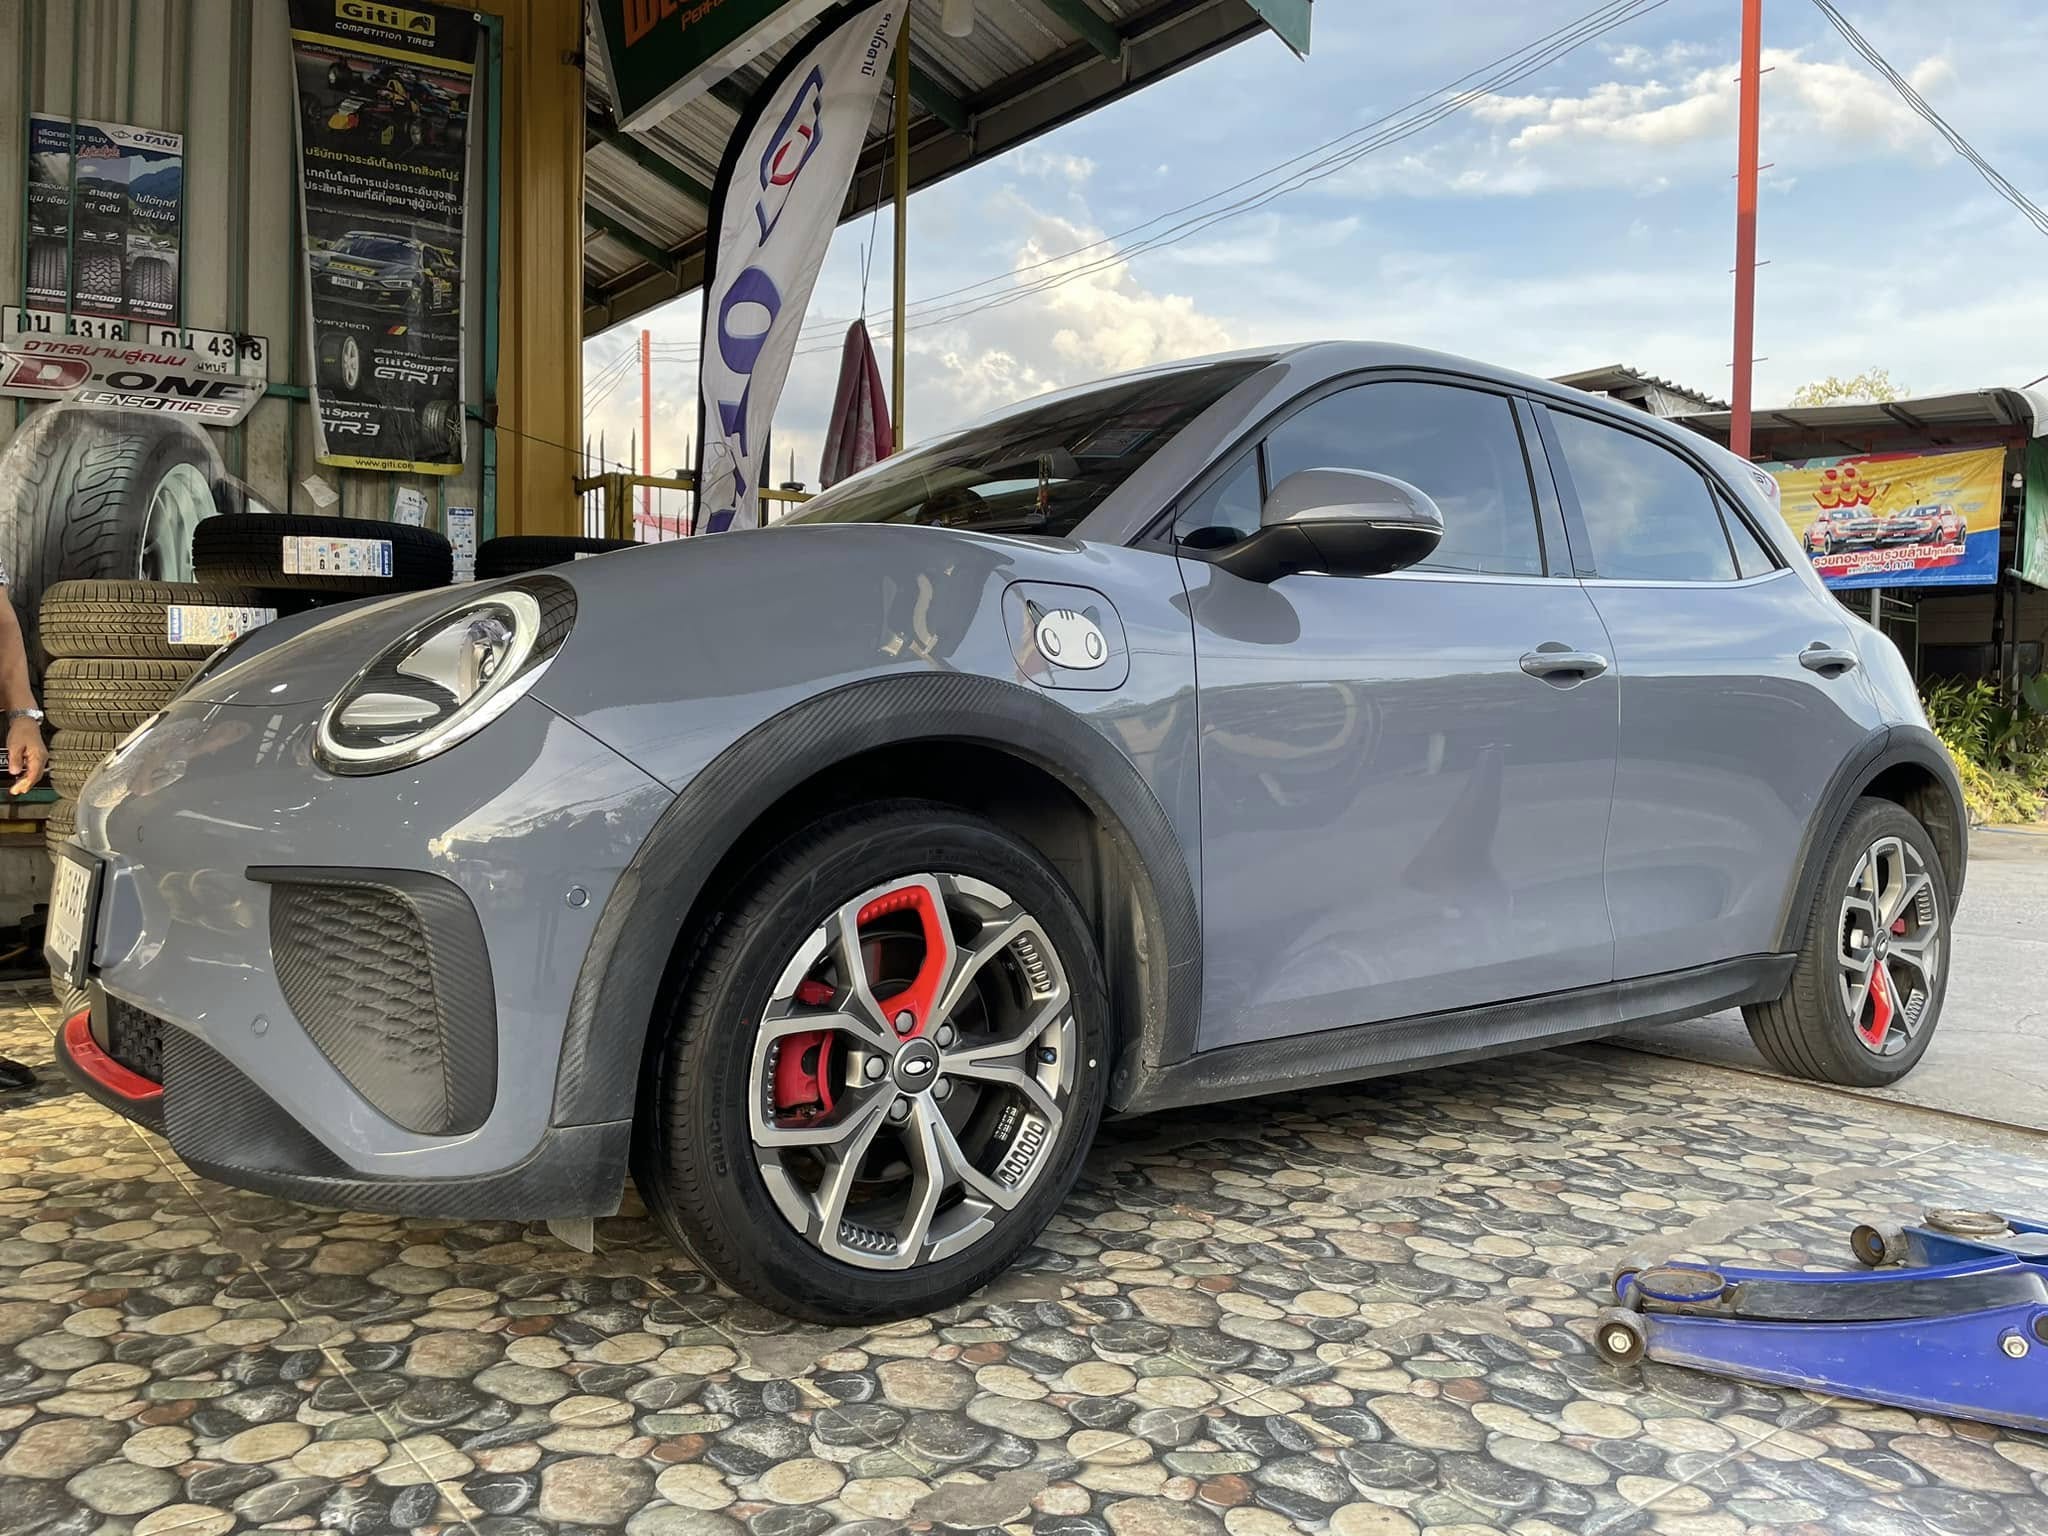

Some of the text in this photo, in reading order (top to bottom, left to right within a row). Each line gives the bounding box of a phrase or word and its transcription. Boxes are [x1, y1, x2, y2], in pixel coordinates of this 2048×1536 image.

[343, 1, 400, 26] Giti
[335, 21, 435, 48] COMPETITION TIRES
[860, 12, 893, 77] ยางโอตานิ
[88, 136, 109, 145] SUV
[133, 133, 179, 149] OTANI
[24, 340, 187, 367] จากสนามสู่ถนน
[374, 356, 455, 374] Giti Compete
[78, 391, 233, 417] LENSO TIRES
[335, 408, 370, 420] Sport
